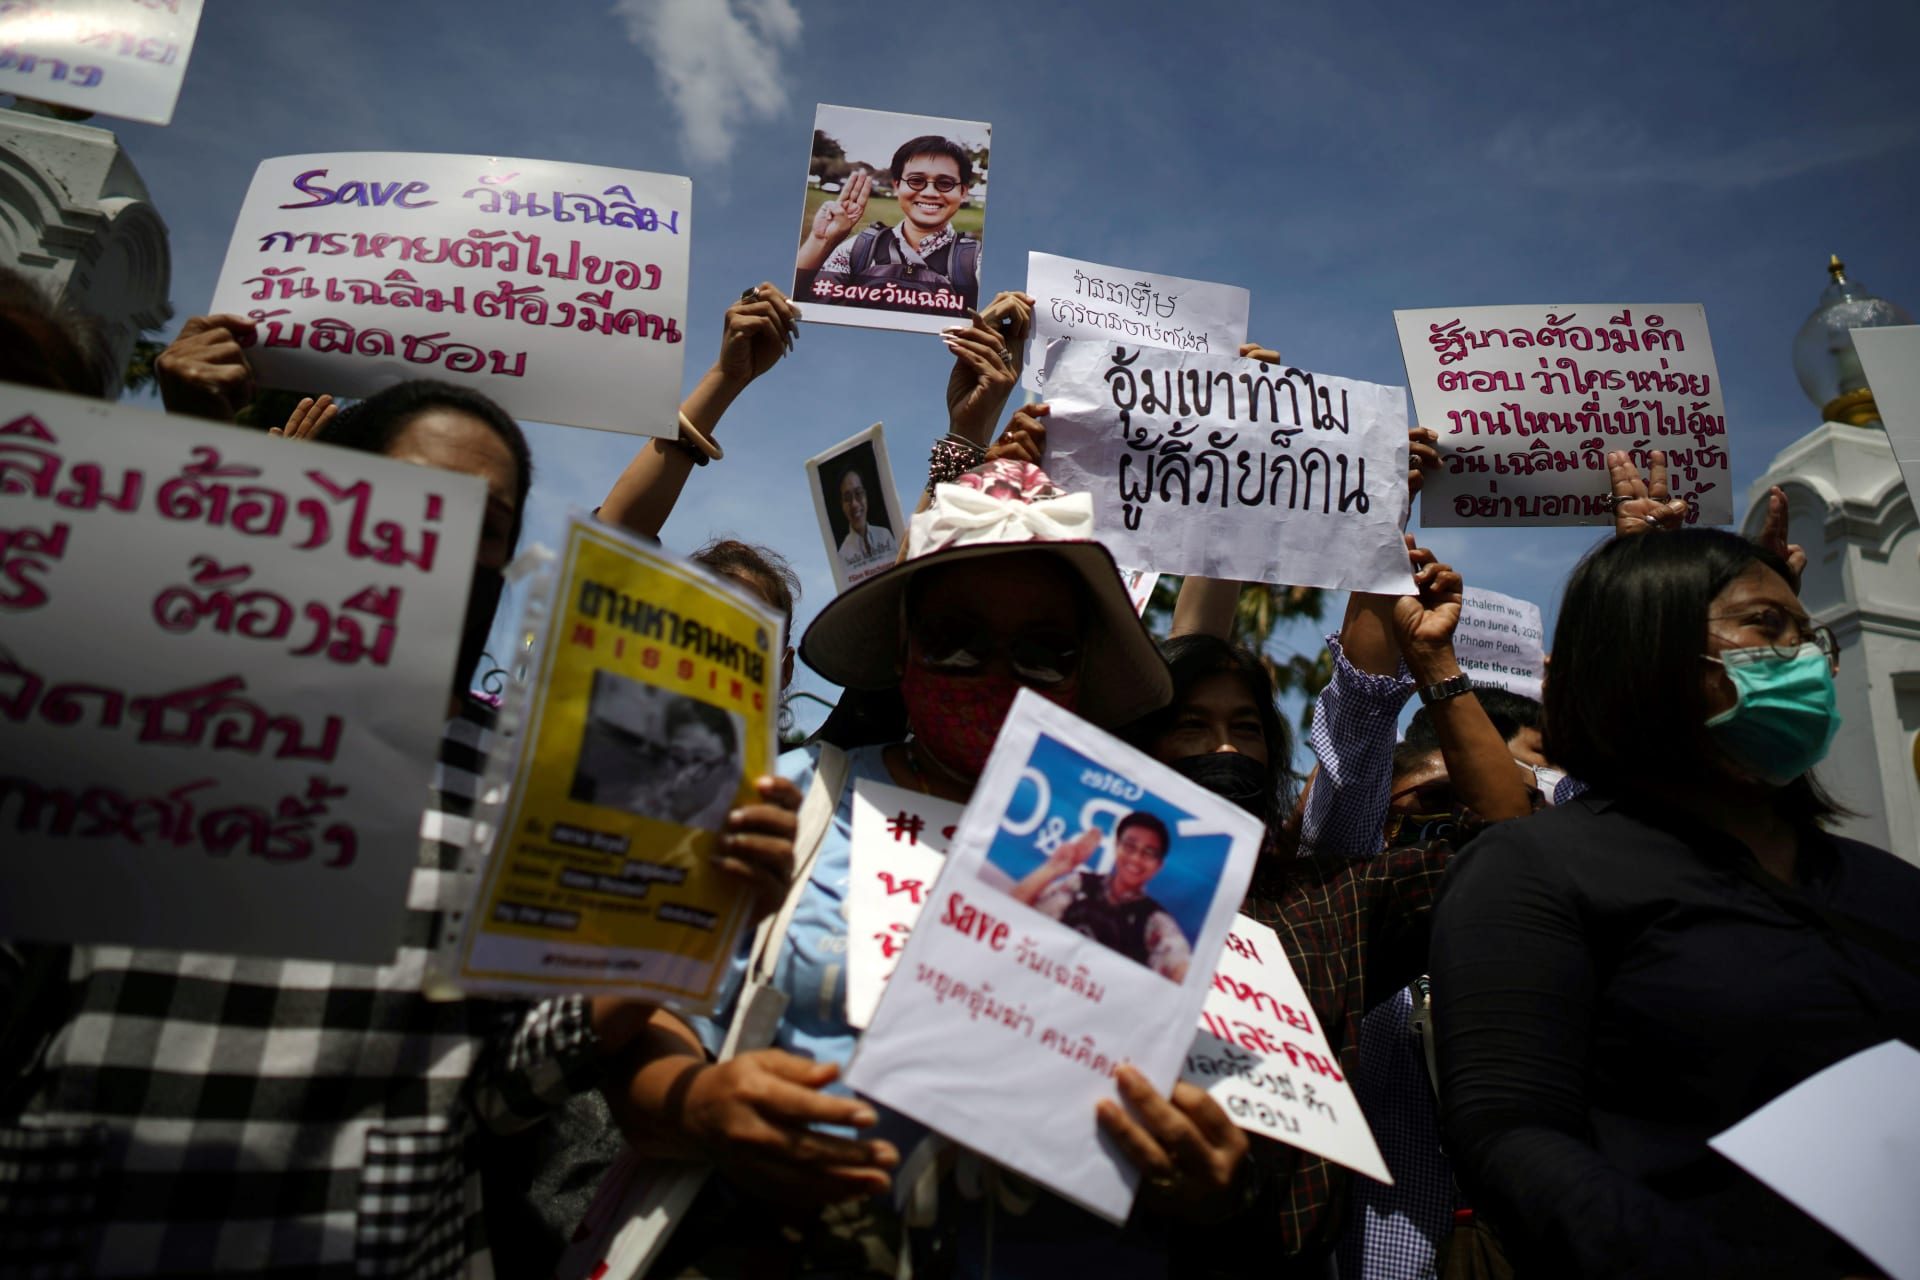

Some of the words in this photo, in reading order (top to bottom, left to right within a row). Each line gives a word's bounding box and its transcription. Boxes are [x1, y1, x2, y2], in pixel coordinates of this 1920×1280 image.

[279, 168, 438, 210] Save
[462, 172, 679, 235] วันเฉลิม
[258, 228, 662, 291] การหายตัวไปของ
[1429, 310, 1685, 365] รัฐบาลต้องมีคำ
[1104, 346, 1349, 439] อุ้มเขาทำไม
[1447, 390, 1725, 448] งานไหนที่เข้าไปอุ้ม
[1119, 421, 1370, 530] ผู้ลี้ภัยก็คน
[1462, 597, 1505, 614] nchalerm
[1473, 619, 1486, 629] on
[1488, 619, 1509, 633] June
[1456, 656, 1490, 671] stigate
[1491, 661, 1508, 674] the
[1510, 666, 1533, 678] case
[1460, 634, 1494, 649] Phnom
[939, 891, 1010, 952] Save
[1015, 936, 1105, 1004] วันเฉลิม
